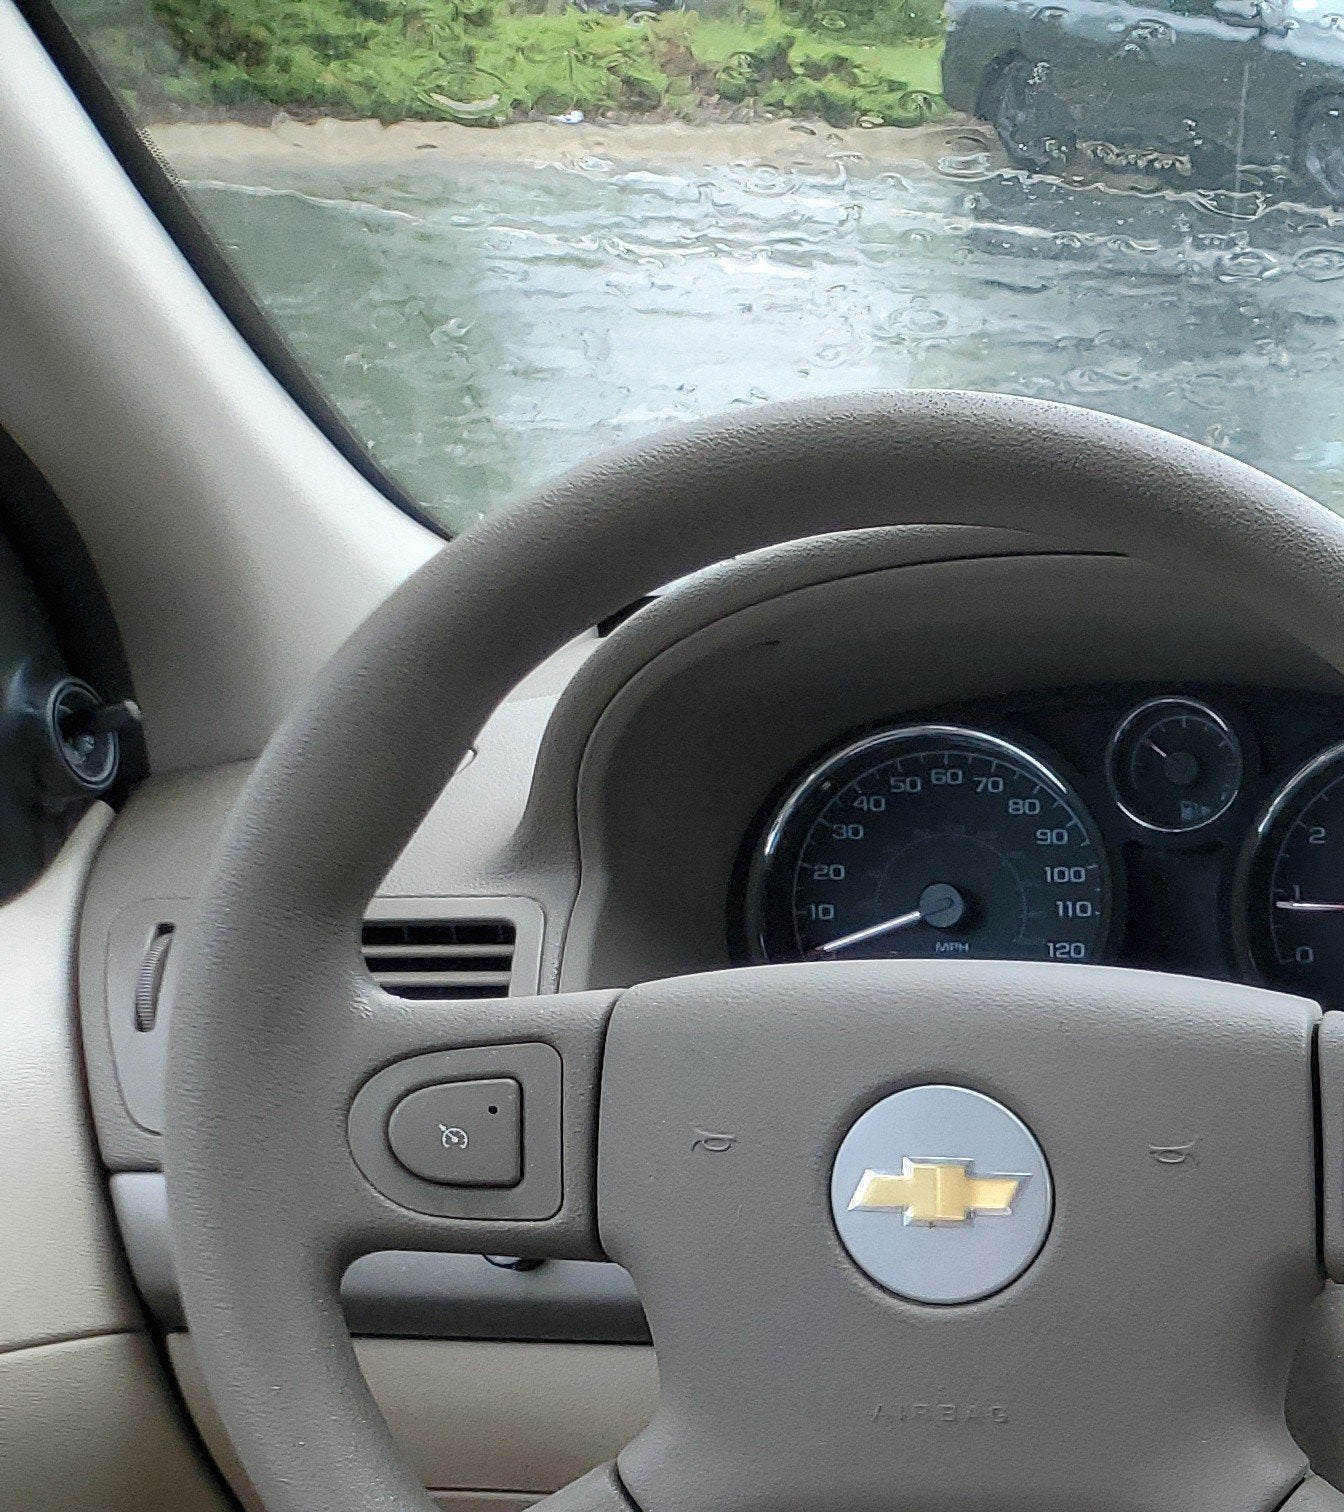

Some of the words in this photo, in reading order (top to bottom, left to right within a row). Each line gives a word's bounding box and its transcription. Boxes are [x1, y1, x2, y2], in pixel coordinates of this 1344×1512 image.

[890, 777, 922, 793] 50
[931, 769, 963, 785] 60
[973, 777, 1004, 793] 70
[853, 796, 886, 812] 40
[1008, 799, 1040, 815] 80
[832, 824, 864, 840] 30
[1036, 829, 1068, 845] 90
[1308, 827, 1326, 844] 2
[813, 865, 845, 881] 20
[1044, 867, 1085, 883] 100
[809, 904, 834, 920] 10
[1056, 901, 1092, 917] 110
[935, 941, 969, 953] MPH
[1046, 942, 1085, 958] 120
[1295, 946, 1314, 963] 0
